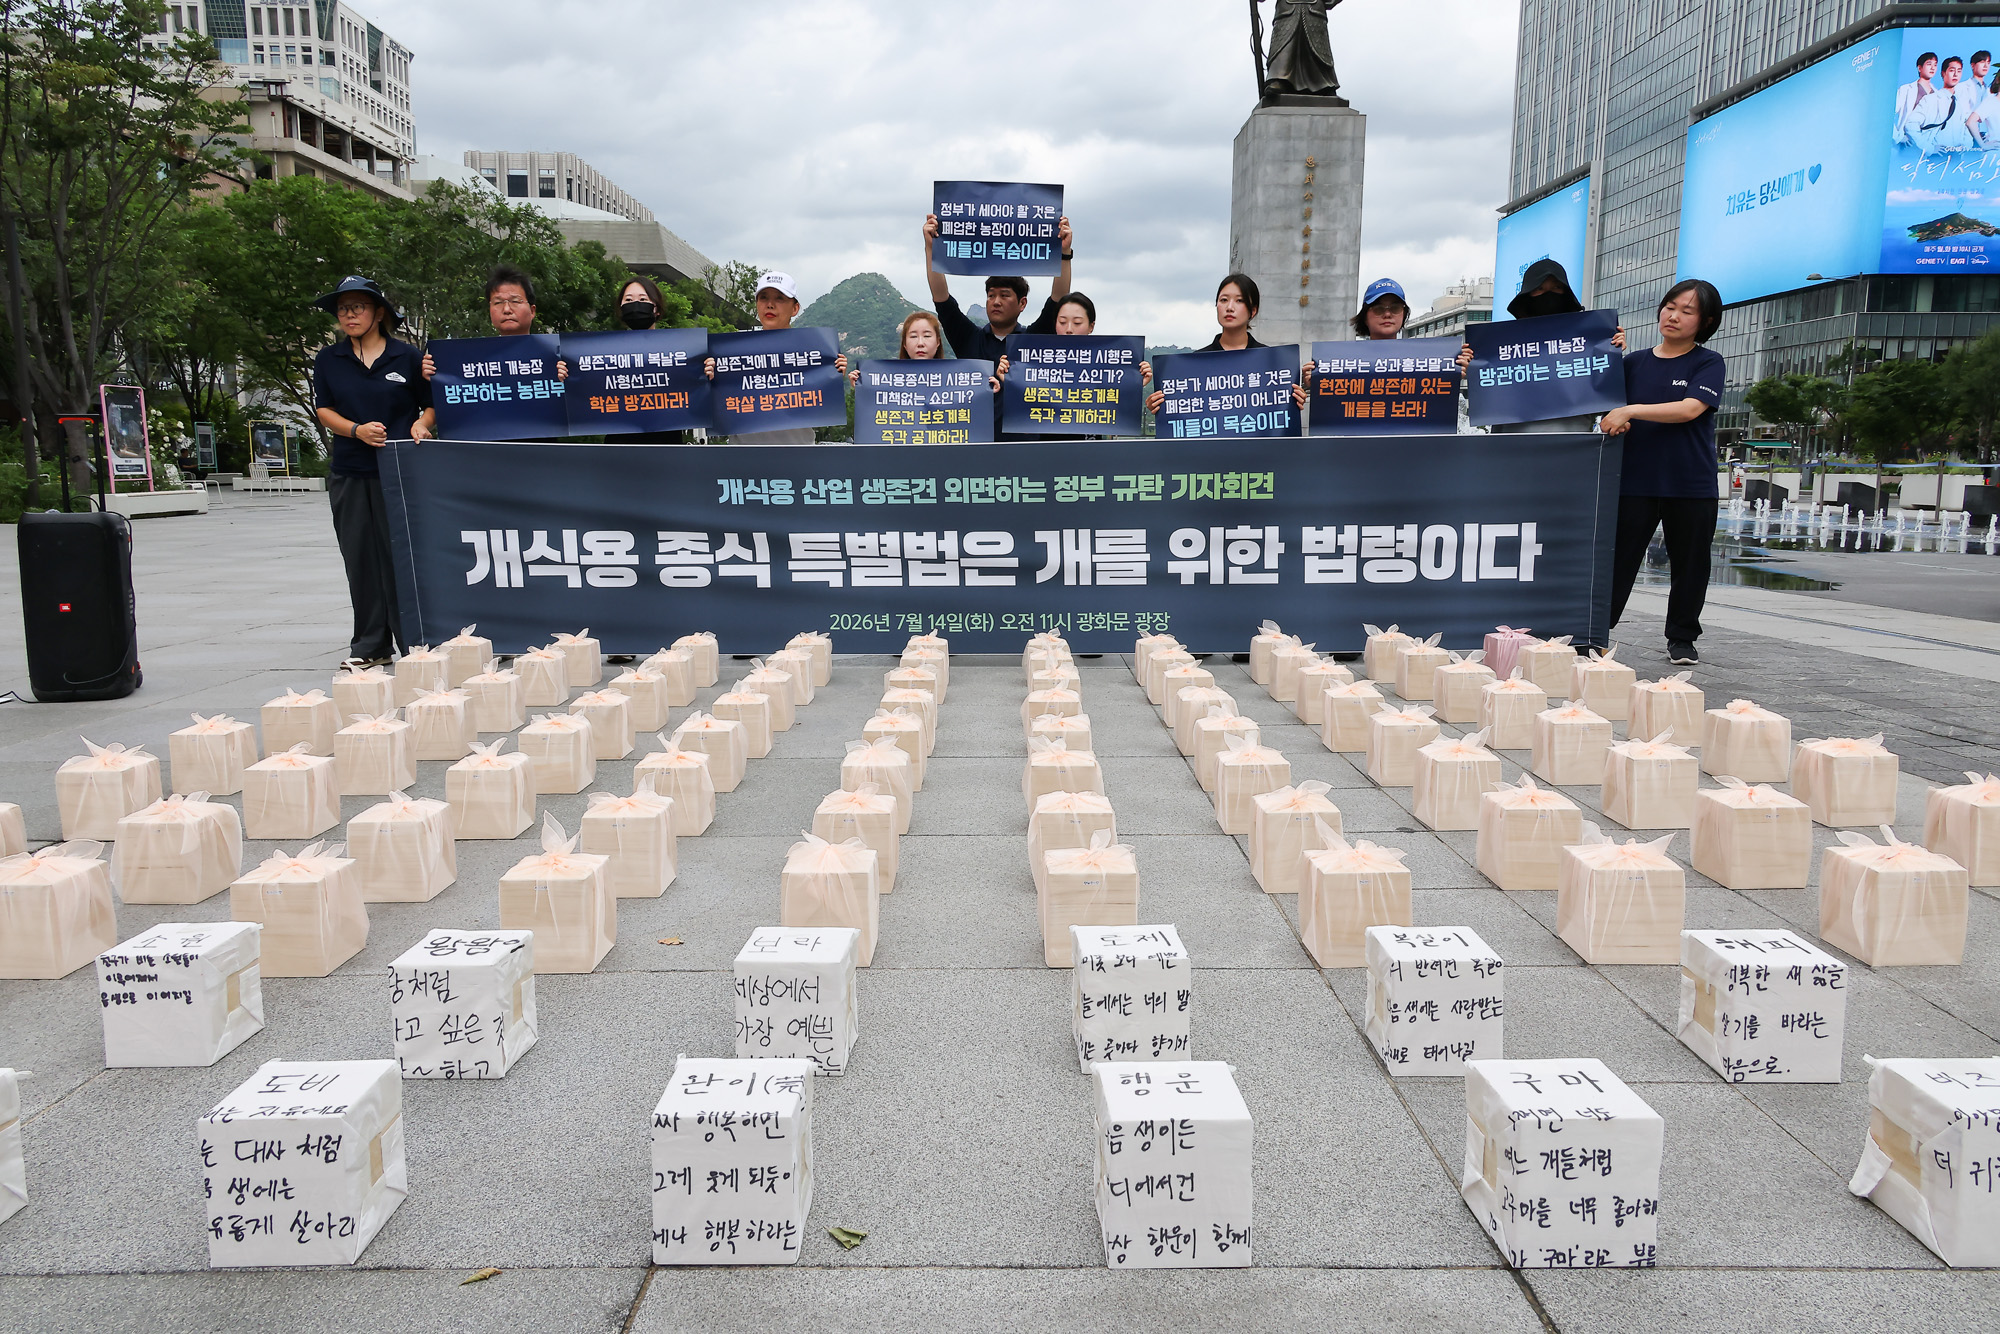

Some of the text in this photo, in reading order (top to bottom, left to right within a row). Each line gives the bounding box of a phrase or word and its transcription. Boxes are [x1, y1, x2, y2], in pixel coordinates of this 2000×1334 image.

[1725, 168, 1805, 216] 치유는 당신에게
[940, 203, 1056, 220] 정부가 세어야 할 것은
[941, 221, 1053, 238] 폐업한 농장이 아니라
[943, 240, 1052, 260] 개들의 목숨이다
[1018, 348, 1133, 365] 개식용종식법 시행은
[1498, 336, 1587, 361] 방치된 개농장
[462, 359, 543, 379] 방치된 개농장
[578, 351, 688, 372] 생존견에게 복날은
[716, 350, 822, 373] 생존견에게 복날은
[1317, 357, 1456, 373] 농림부는 성과홍보말고
[1479, 353, 1610, 387] 방관하는 농림부
[605, 372, 670, 390] 사형선고다
[741, 371, 805, 390] 사형선고다
[868, 371, 983, 387] 개식용종식법 시행은
[1025, 368, 1124, 384] 대책없는 쇼인가?
[1162, 369, 1292, 395] 정부가 세어야 할 것은
[1319, 377, 1452, 396] 현장에 생존해 있는
[444, 379, 566, 404] 방관하는 농림부
[589, 391, 690, 414] 학살 방조마라!
[725, 389, 823, 414] 학살 방조마라!
[875, 390, 975, 406] 대책없는 쇼인가?
[1023, 387, 1120, 404] 생존견 보호계획
[1165, 389, 1291, 414] 폐업한 농장이 아니라
[875, 408, 971, 425] 생존견 보호계획
[1029, 407, 1116, 425] 즉각 공개하라!
[1340, 400, 1427, 418] 개들을 보라!
[1167, 410, 1291, 438] 개들의 목숨이다
[881, 429, 969, 444] 즉각 공개하라!
[717, 471, 1274, 505] 개식용 산업 생존견 외면하는 정부 규탄 기자회견
[460, 521, 1543, 588] 개식용 종식 특별법은 개를 위한 법령이다
[829, 612, 1171, 633] 2026년 7월 14일(화) 오전 11시 광화문 광장
[1786, 964, 1803, 986] 새
[734, 974, 820, 1008] 세상에서
[1144, 991, 1167, 1014] 너의
[438, 1013, 485, 1046] 싶은
[735, 1013, 834, 1054] 가장 예쁜
[1781, 1011, 1830, 1040] 바라는
[257, 1073, 341, 1094] 도비
[1133, 1117, 1196, 1156] 생이든
[234, 1139, 287, 1164] 대사
[295, 1132, 343, 1165] 처럼
[1539, 1146, 1613, 1181] 개들처럼
[227, 1176, 296, 1206] 생에는
[1569, 1196, 1598, 1225] 너무
[207, 1213, 274, 1243] 유롭게
[1147, 1224, 1196, 1259] 행운이
[1212, 1222, 1251, 1253] 함께
